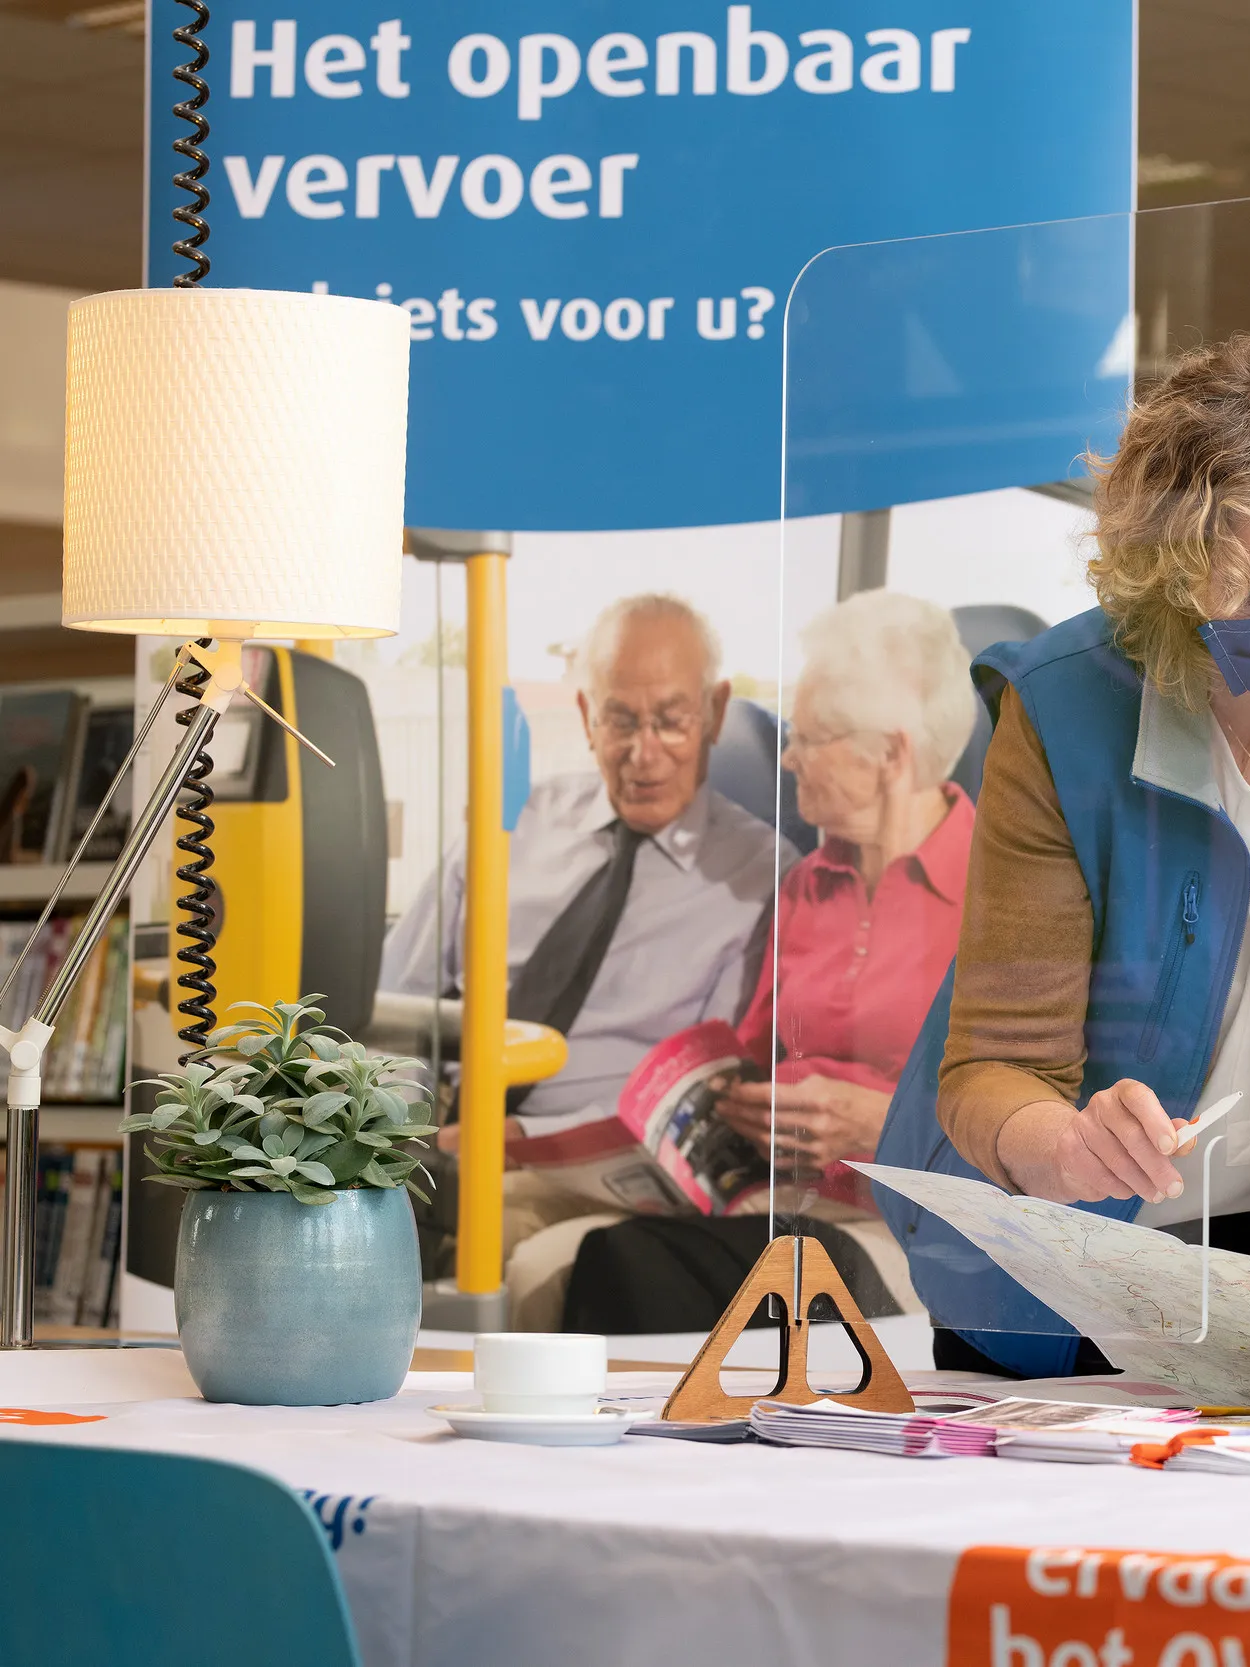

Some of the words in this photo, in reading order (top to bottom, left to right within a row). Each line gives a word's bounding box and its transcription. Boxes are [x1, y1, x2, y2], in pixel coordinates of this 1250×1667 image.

[230, 18, 411, 98] Het
[448, 5, 972, 120] openbaar
[224, 154, 639, 219] vervoer
[520, 295, 672, 341] voor
[696, 289, 776, 341] u?
